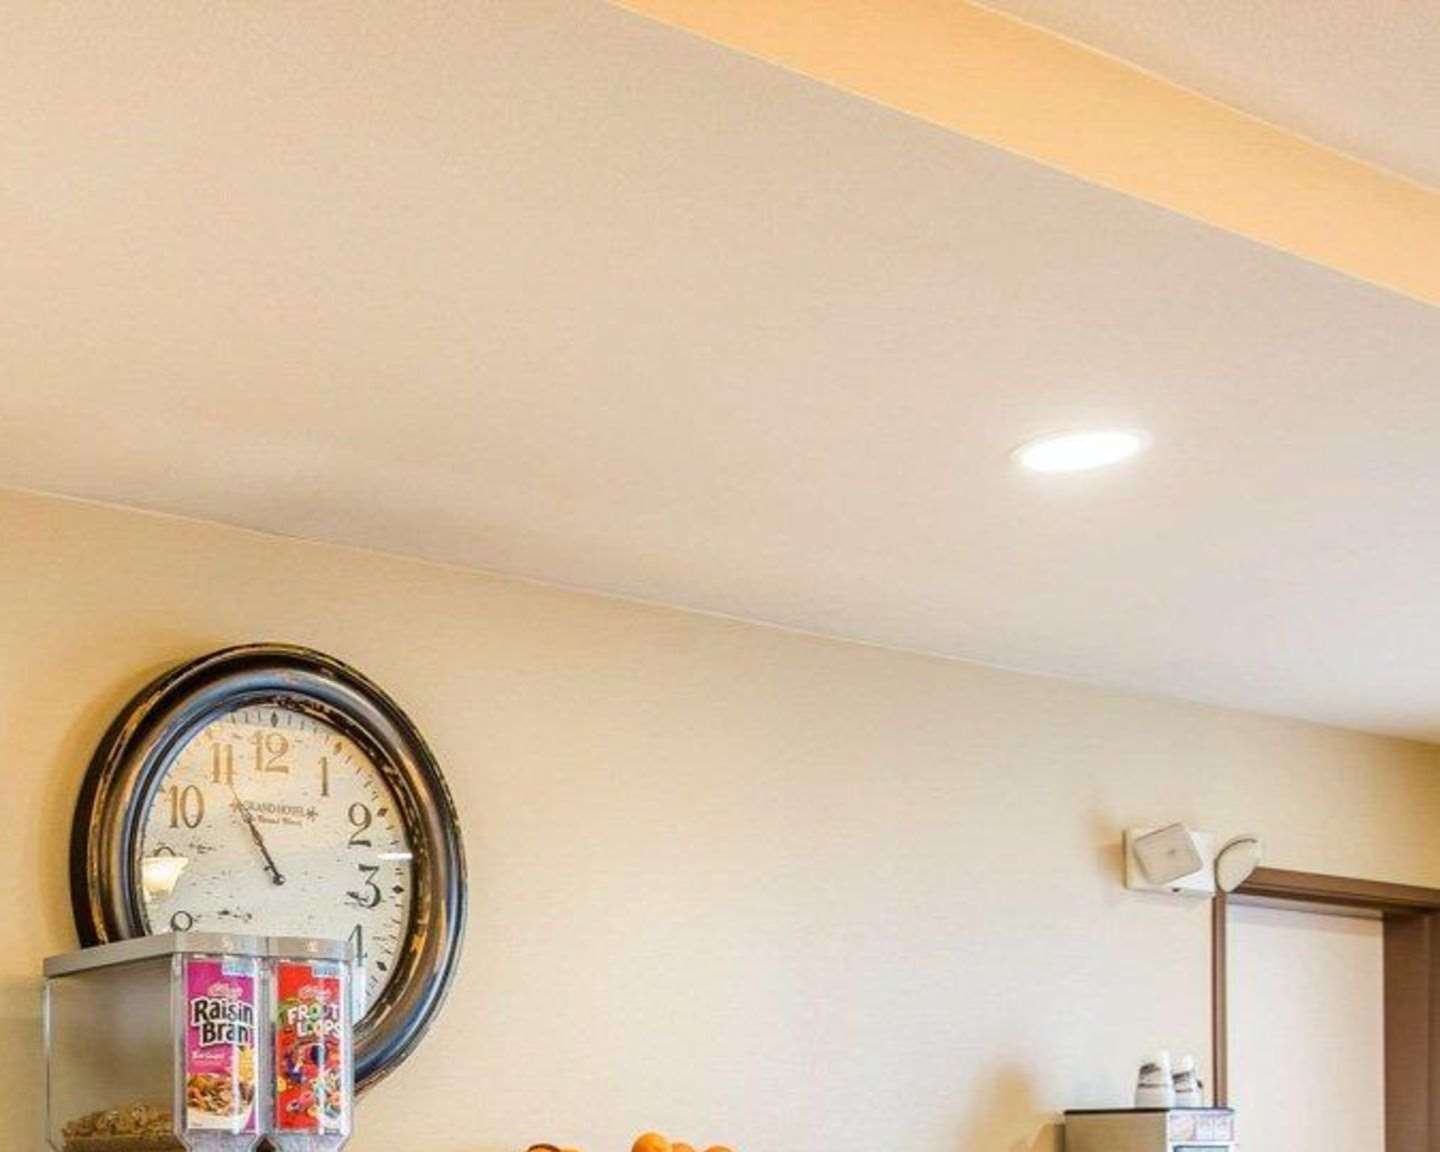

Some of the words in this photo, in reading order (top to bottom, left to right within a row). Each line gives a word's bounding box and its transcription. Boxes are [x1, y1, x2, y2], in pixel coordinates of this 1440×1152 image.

[211, 742, 234, 785] 11
[254, 732, 289, 774] 12
[319, 756, 329, 797] 1
[168, 784, 206, 829] 10
[347, 802, 372, 848] 2
[346, 863, 381, 909] 3
[193, 998, 254, 1026] Raisin
[201, 1021, 249, 1045] Bran
